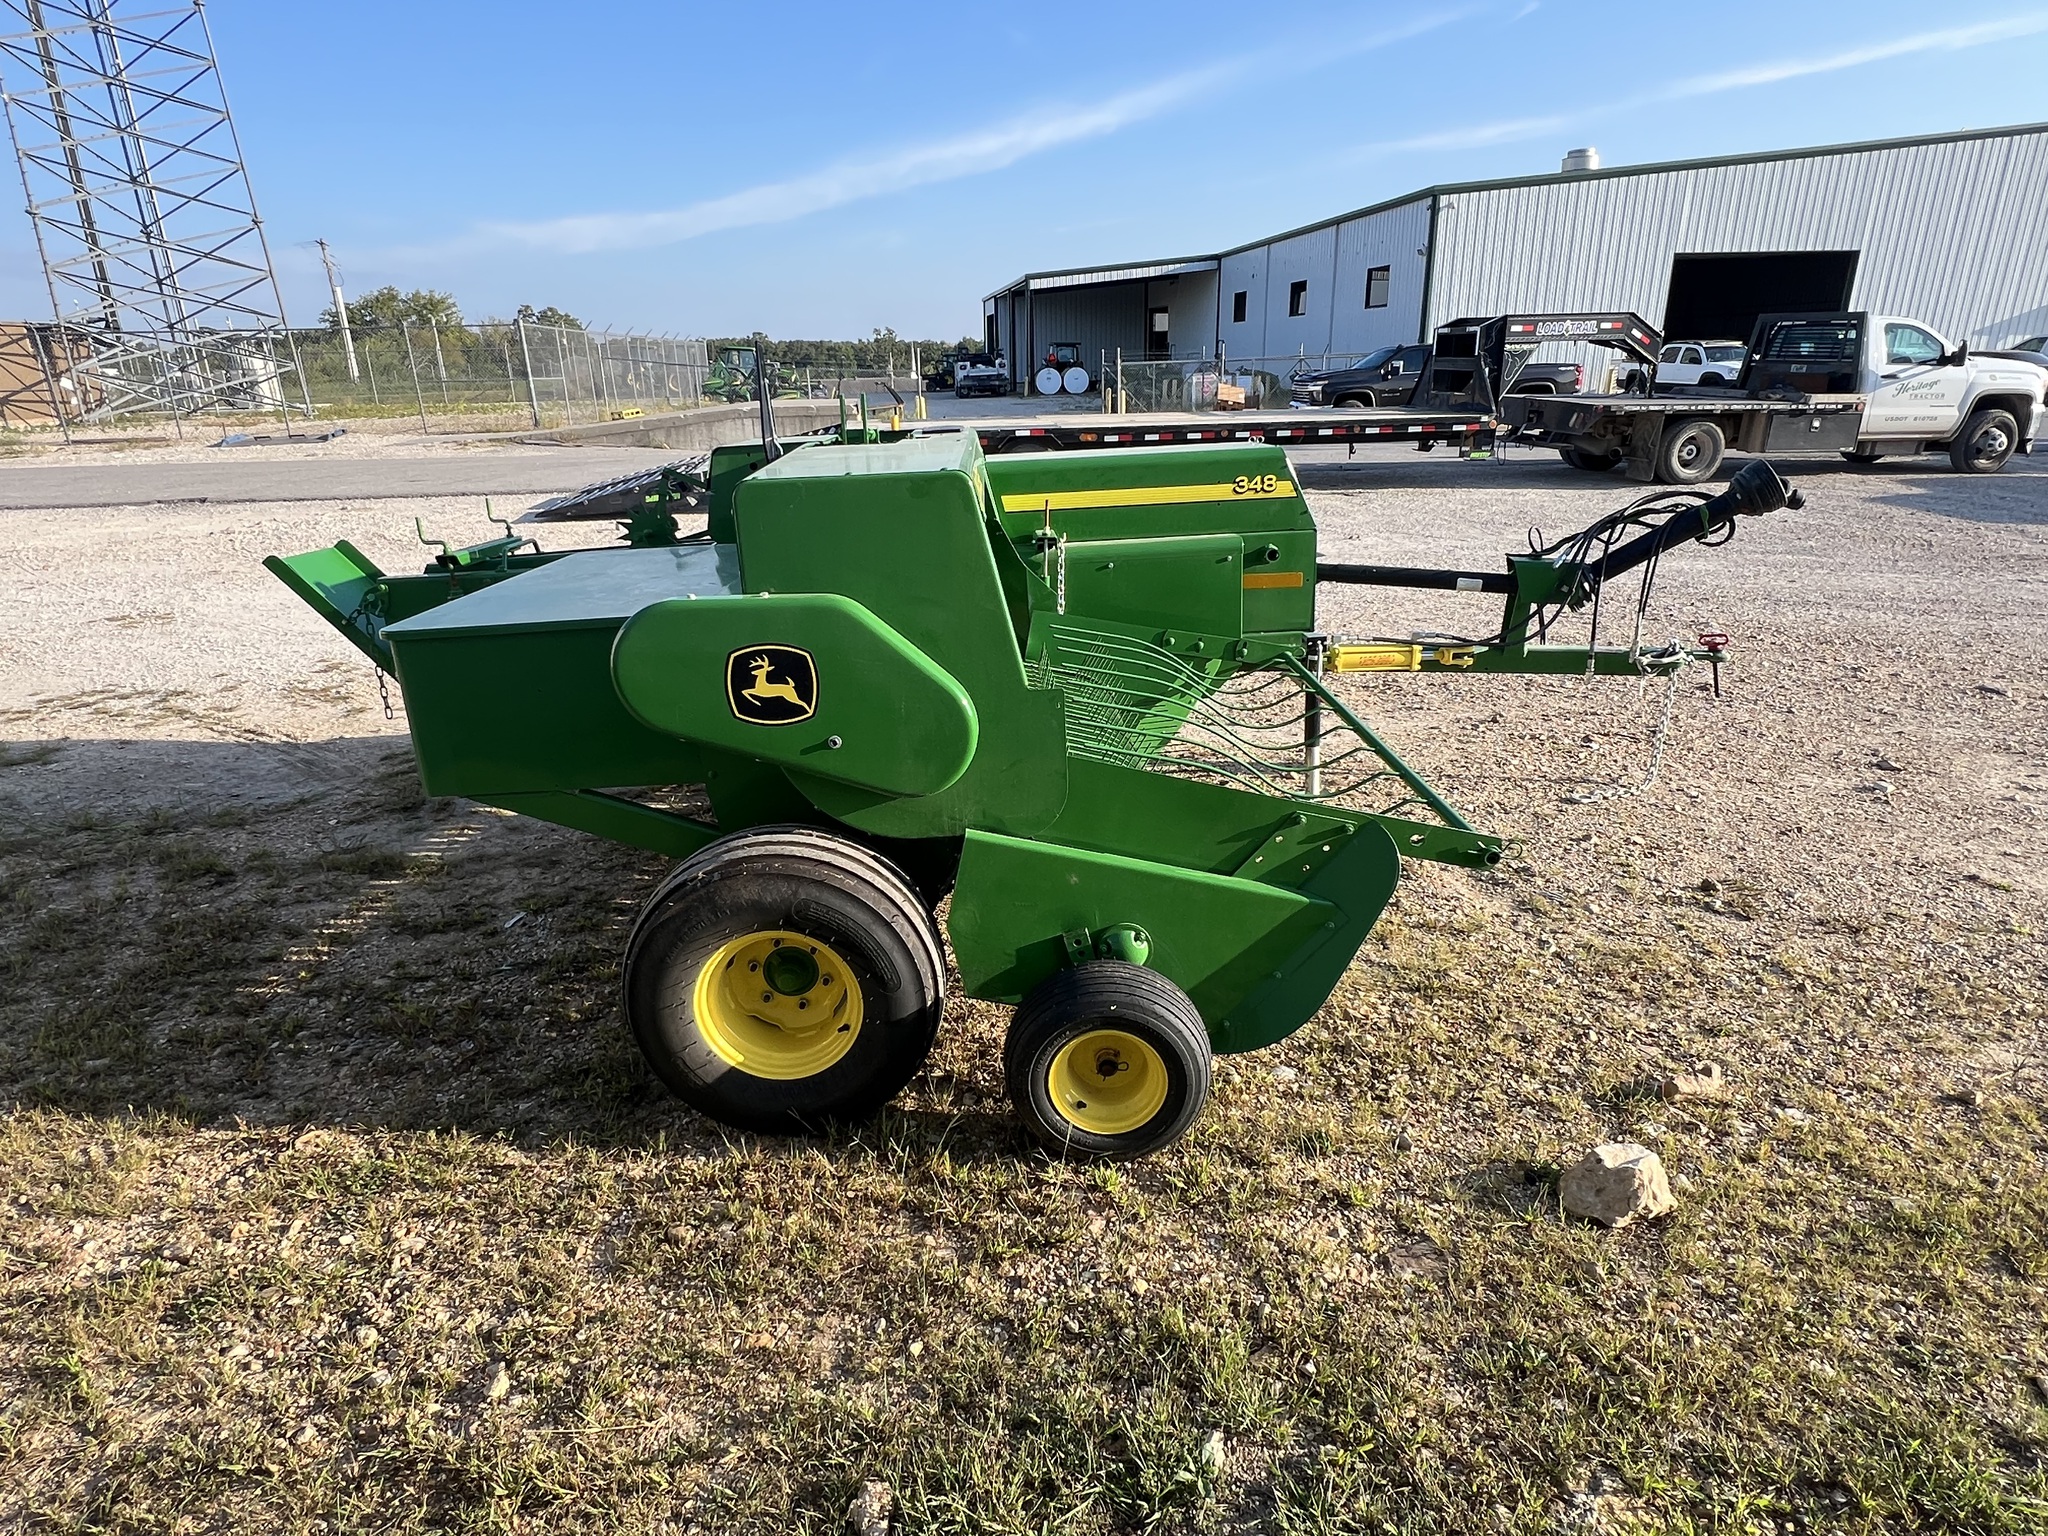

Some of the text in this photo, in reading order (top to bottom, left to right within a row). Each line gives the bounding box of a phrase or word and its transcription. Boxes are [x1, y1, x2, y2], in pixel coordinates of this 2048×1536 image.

[1536, 320, 1598, 335] LOAD TRAIL
[1892, 379, 1941, 398] Heritage
[1232, 473, 1277, 495] 348
